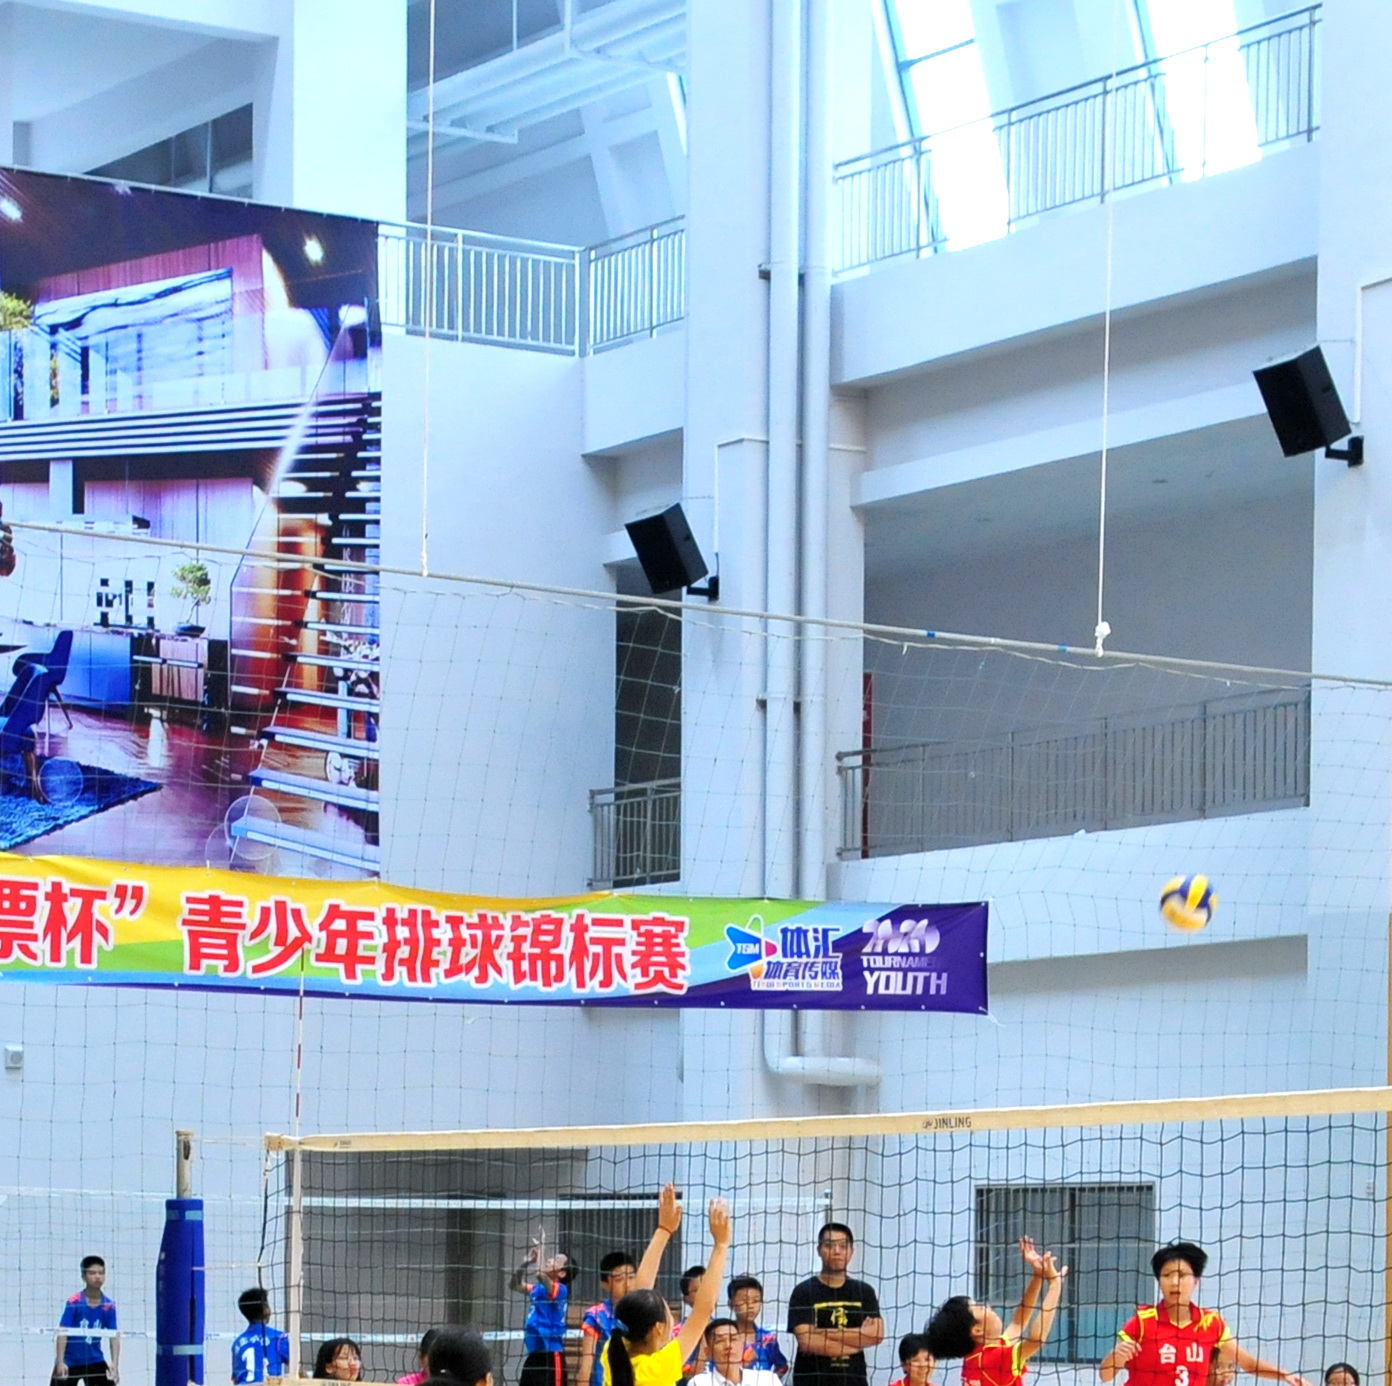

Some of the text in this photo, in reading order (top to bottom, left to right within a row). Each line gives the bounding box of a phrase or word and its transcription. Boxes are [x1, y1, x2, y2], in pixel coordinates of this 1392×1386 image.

[181, 892, 689, 993] 青少年排球锦标赛
[863, 970, 948, 995] YOUTH
[933, 1116, 972, 1130] JINLING
[1159, 1342, 1204, 1363] 台山
